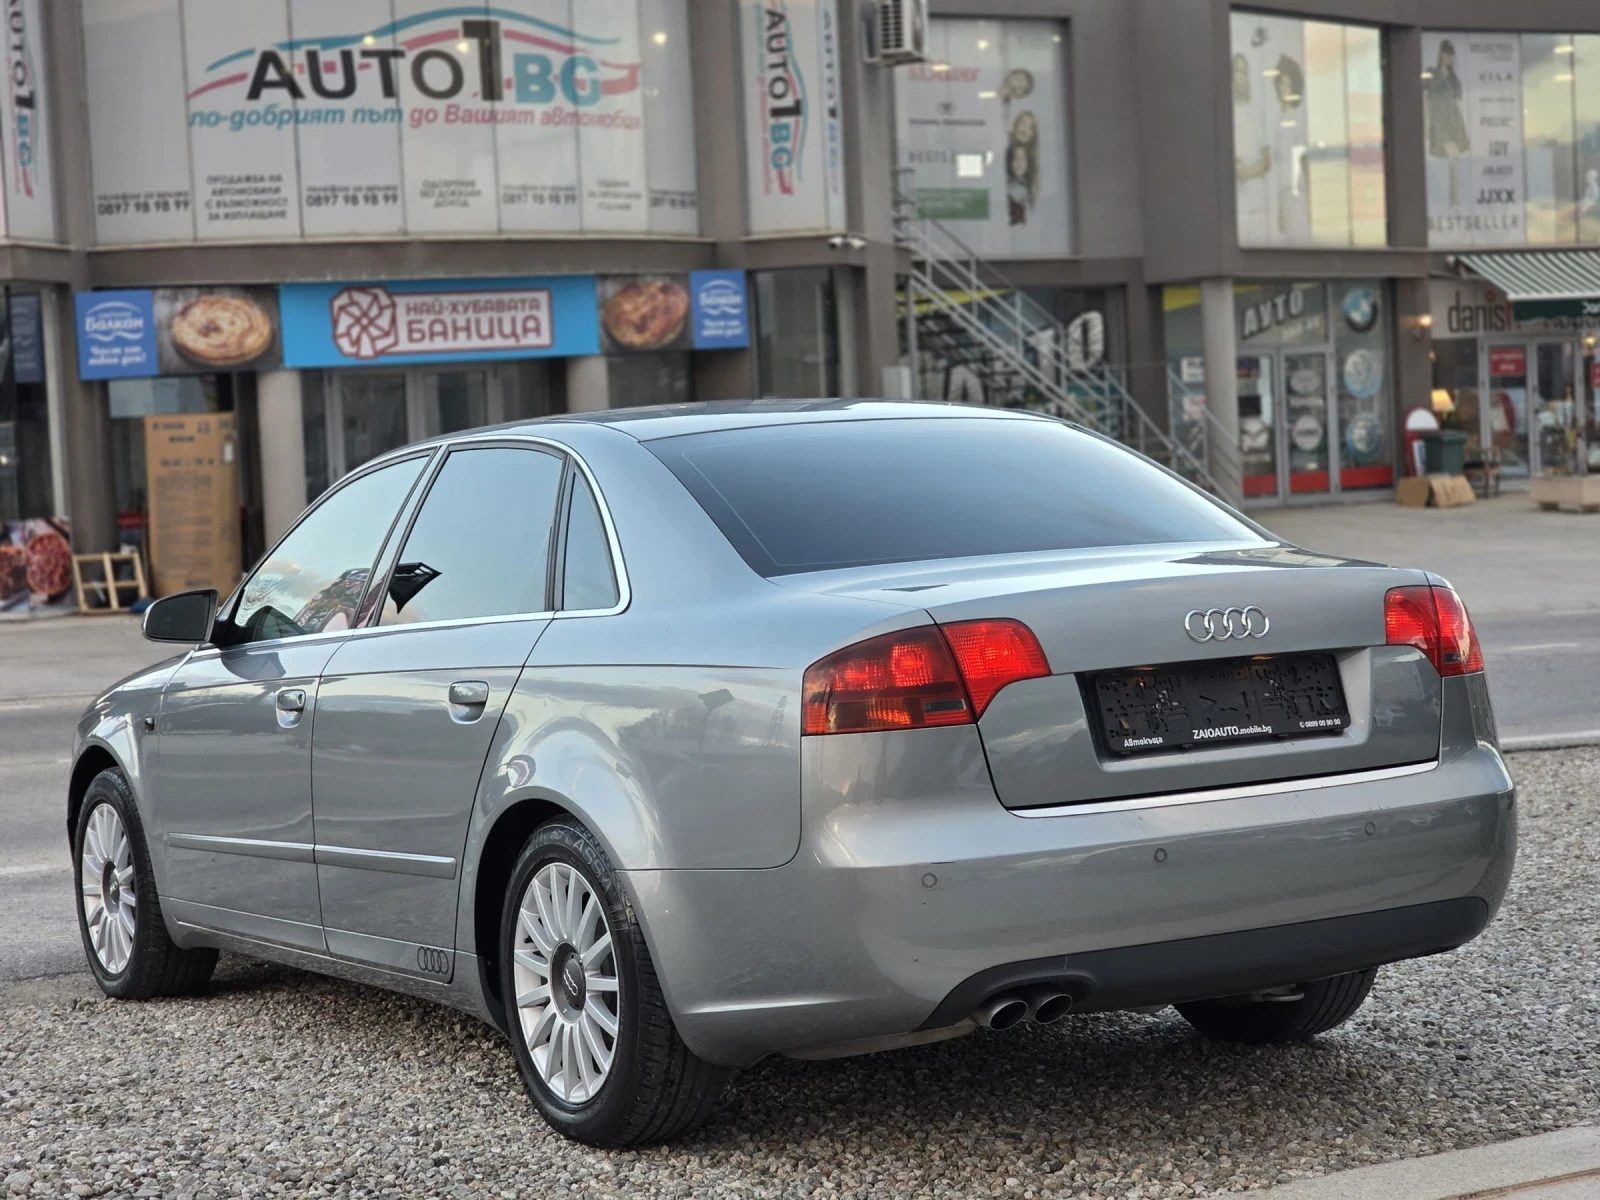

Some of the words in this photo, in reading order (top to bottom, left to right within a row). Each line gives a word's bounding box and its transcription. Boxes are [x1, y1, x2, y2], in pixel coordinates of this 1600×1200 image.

[8, 0, 36, 167] UTO1BG
[766, 8, 803, 170] AUTO1BG
[190, 102, 346, 132] по-добрият
[352, 107, 404, 124] път
[410, 108, 439, 128] до
[444, 104, 535, 125] Вашият
[1477, 188, 1514, 203] JJXX
[97, 200, 129, 215] 0897
[133, 200, 150, 213] 98
[153, 199, 170, 212] 98
[173, 198, 189, 211] 99
[407, 296, 541, 316] НАЙ-ХУБАВАТА
[86, 316, 145, 333] Балкан
[408, 313, 541, 344] БАНИЦА
[1192, 724, 1273, 740] ZAIOAUTO.mobile.bg
